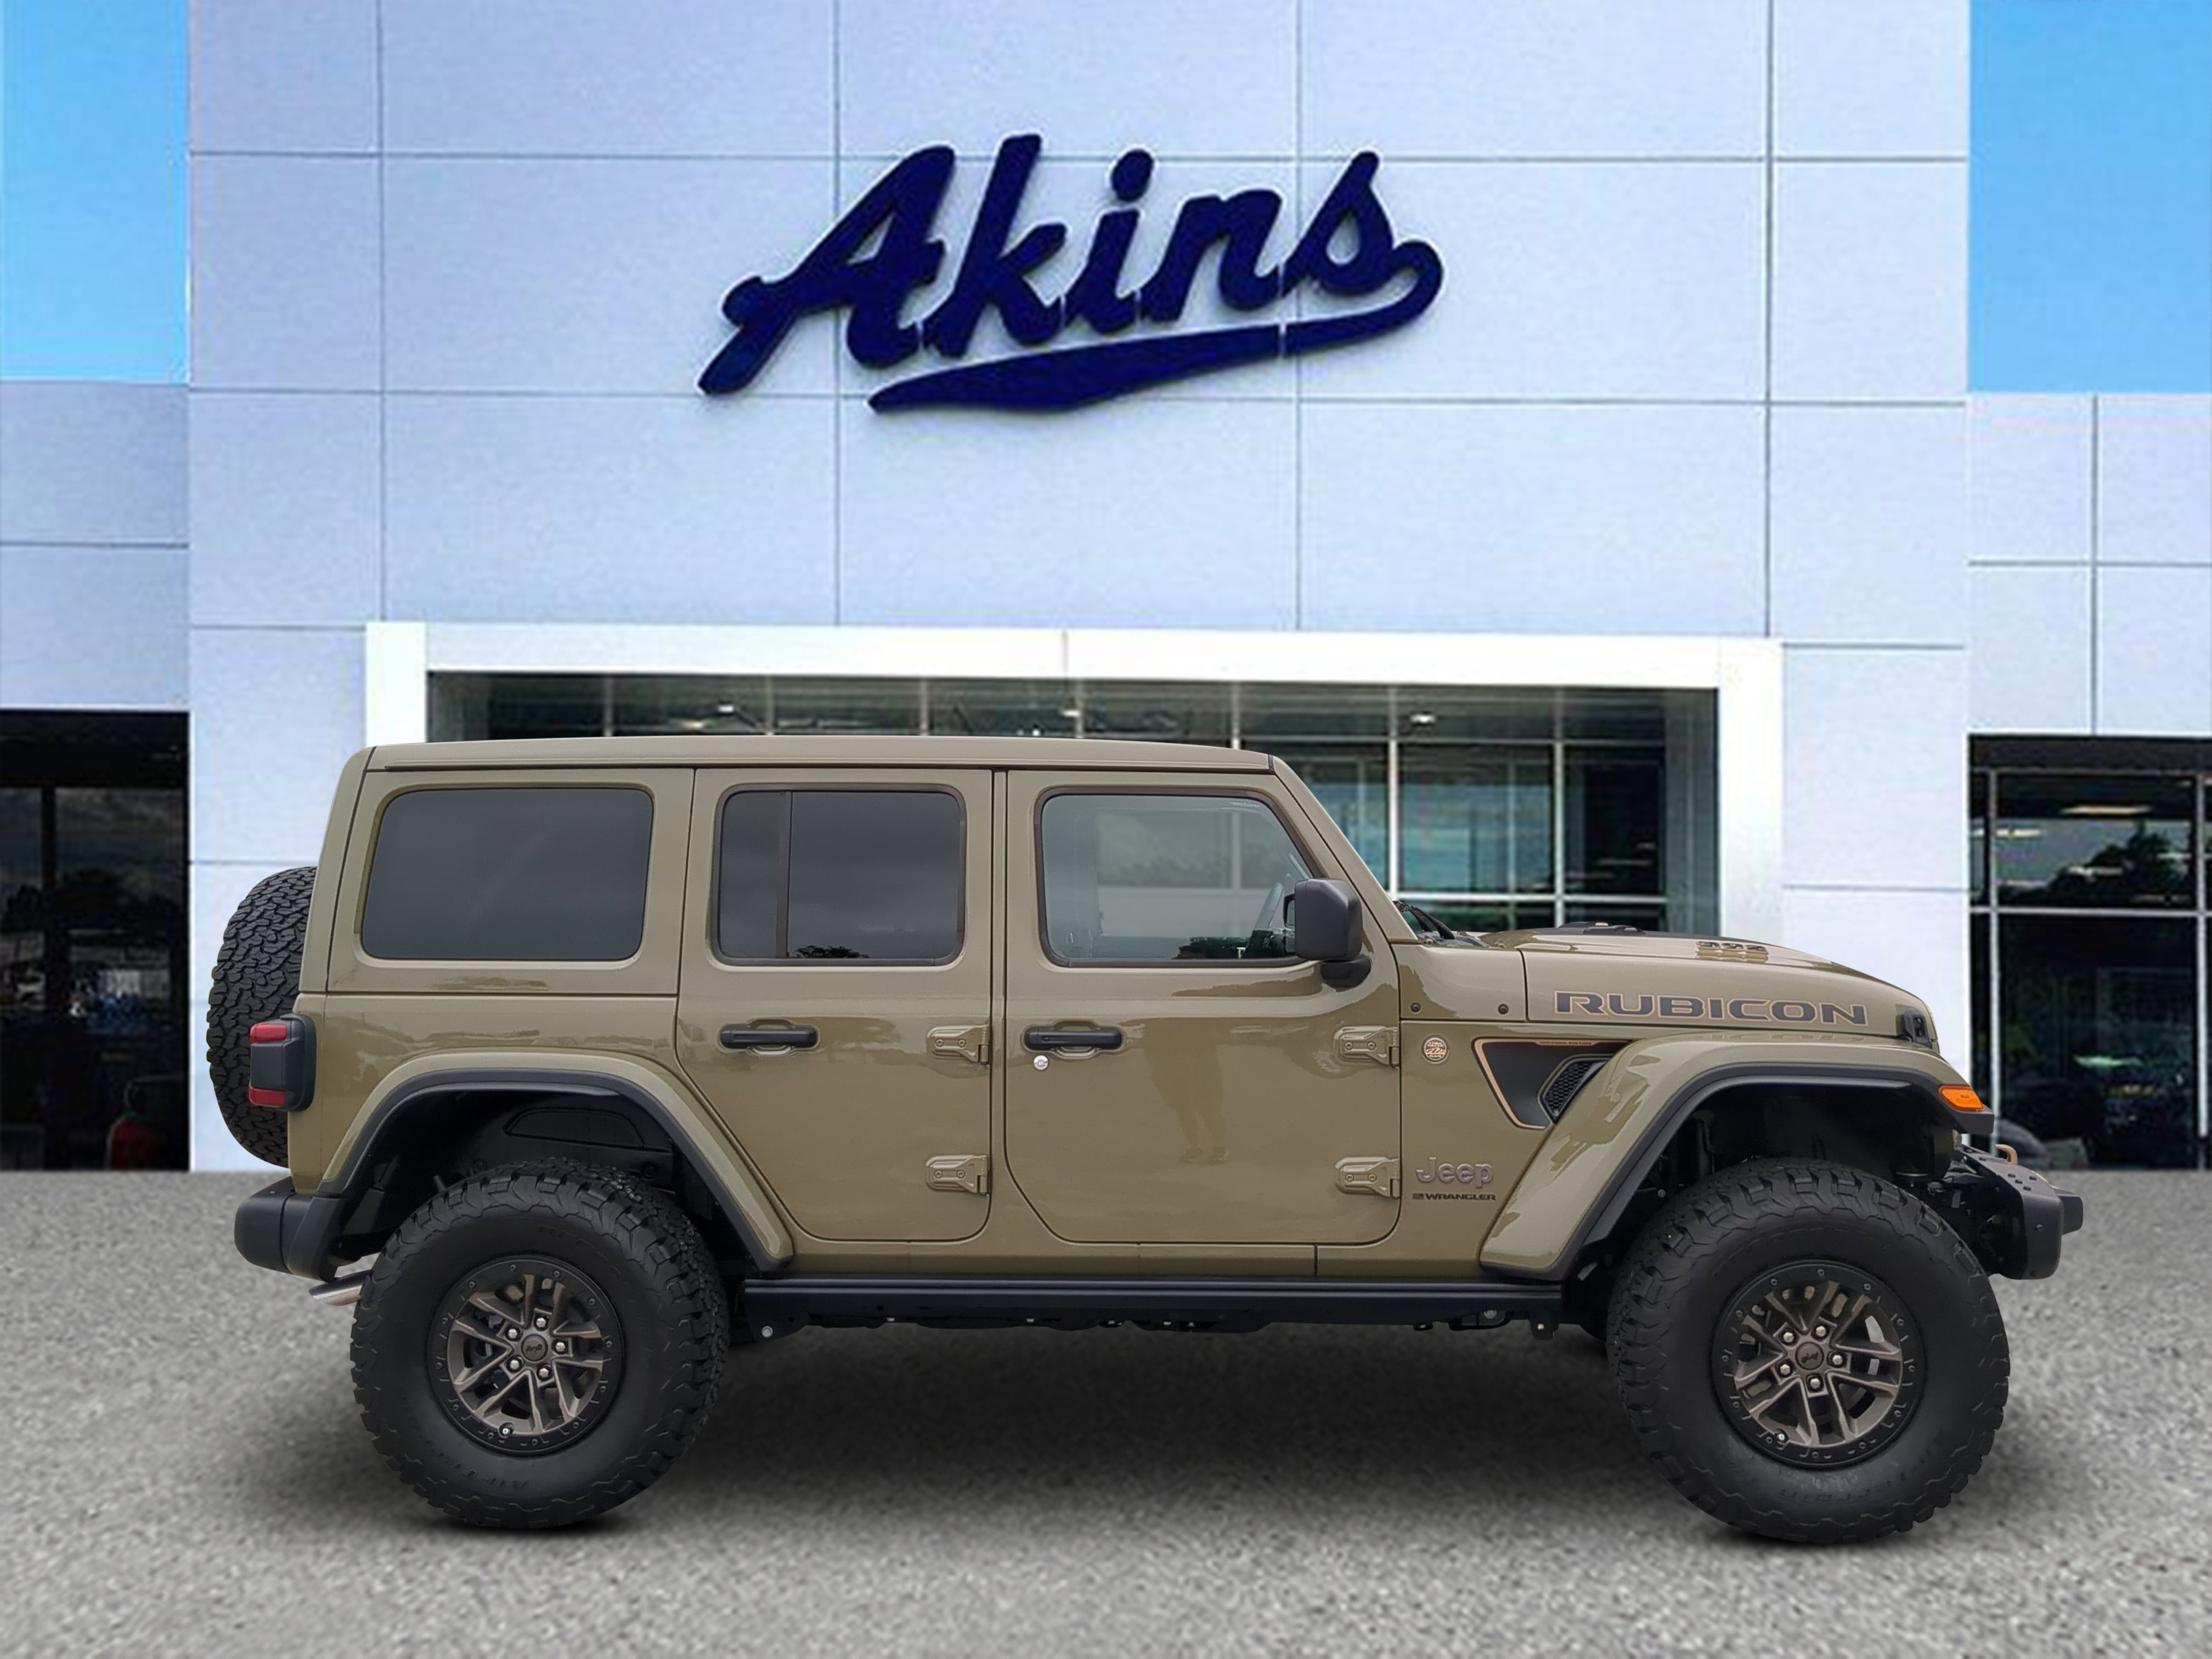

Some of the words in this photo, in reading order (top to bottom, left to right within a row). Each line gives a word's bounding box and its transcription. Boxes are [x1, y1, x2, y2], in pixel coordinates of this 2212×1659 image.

[699, 134, 1443, 413] Akins
[1554, 991, 1868, 1025] RUBICON
[1415, 1156, 1493, 1189] Jeep
